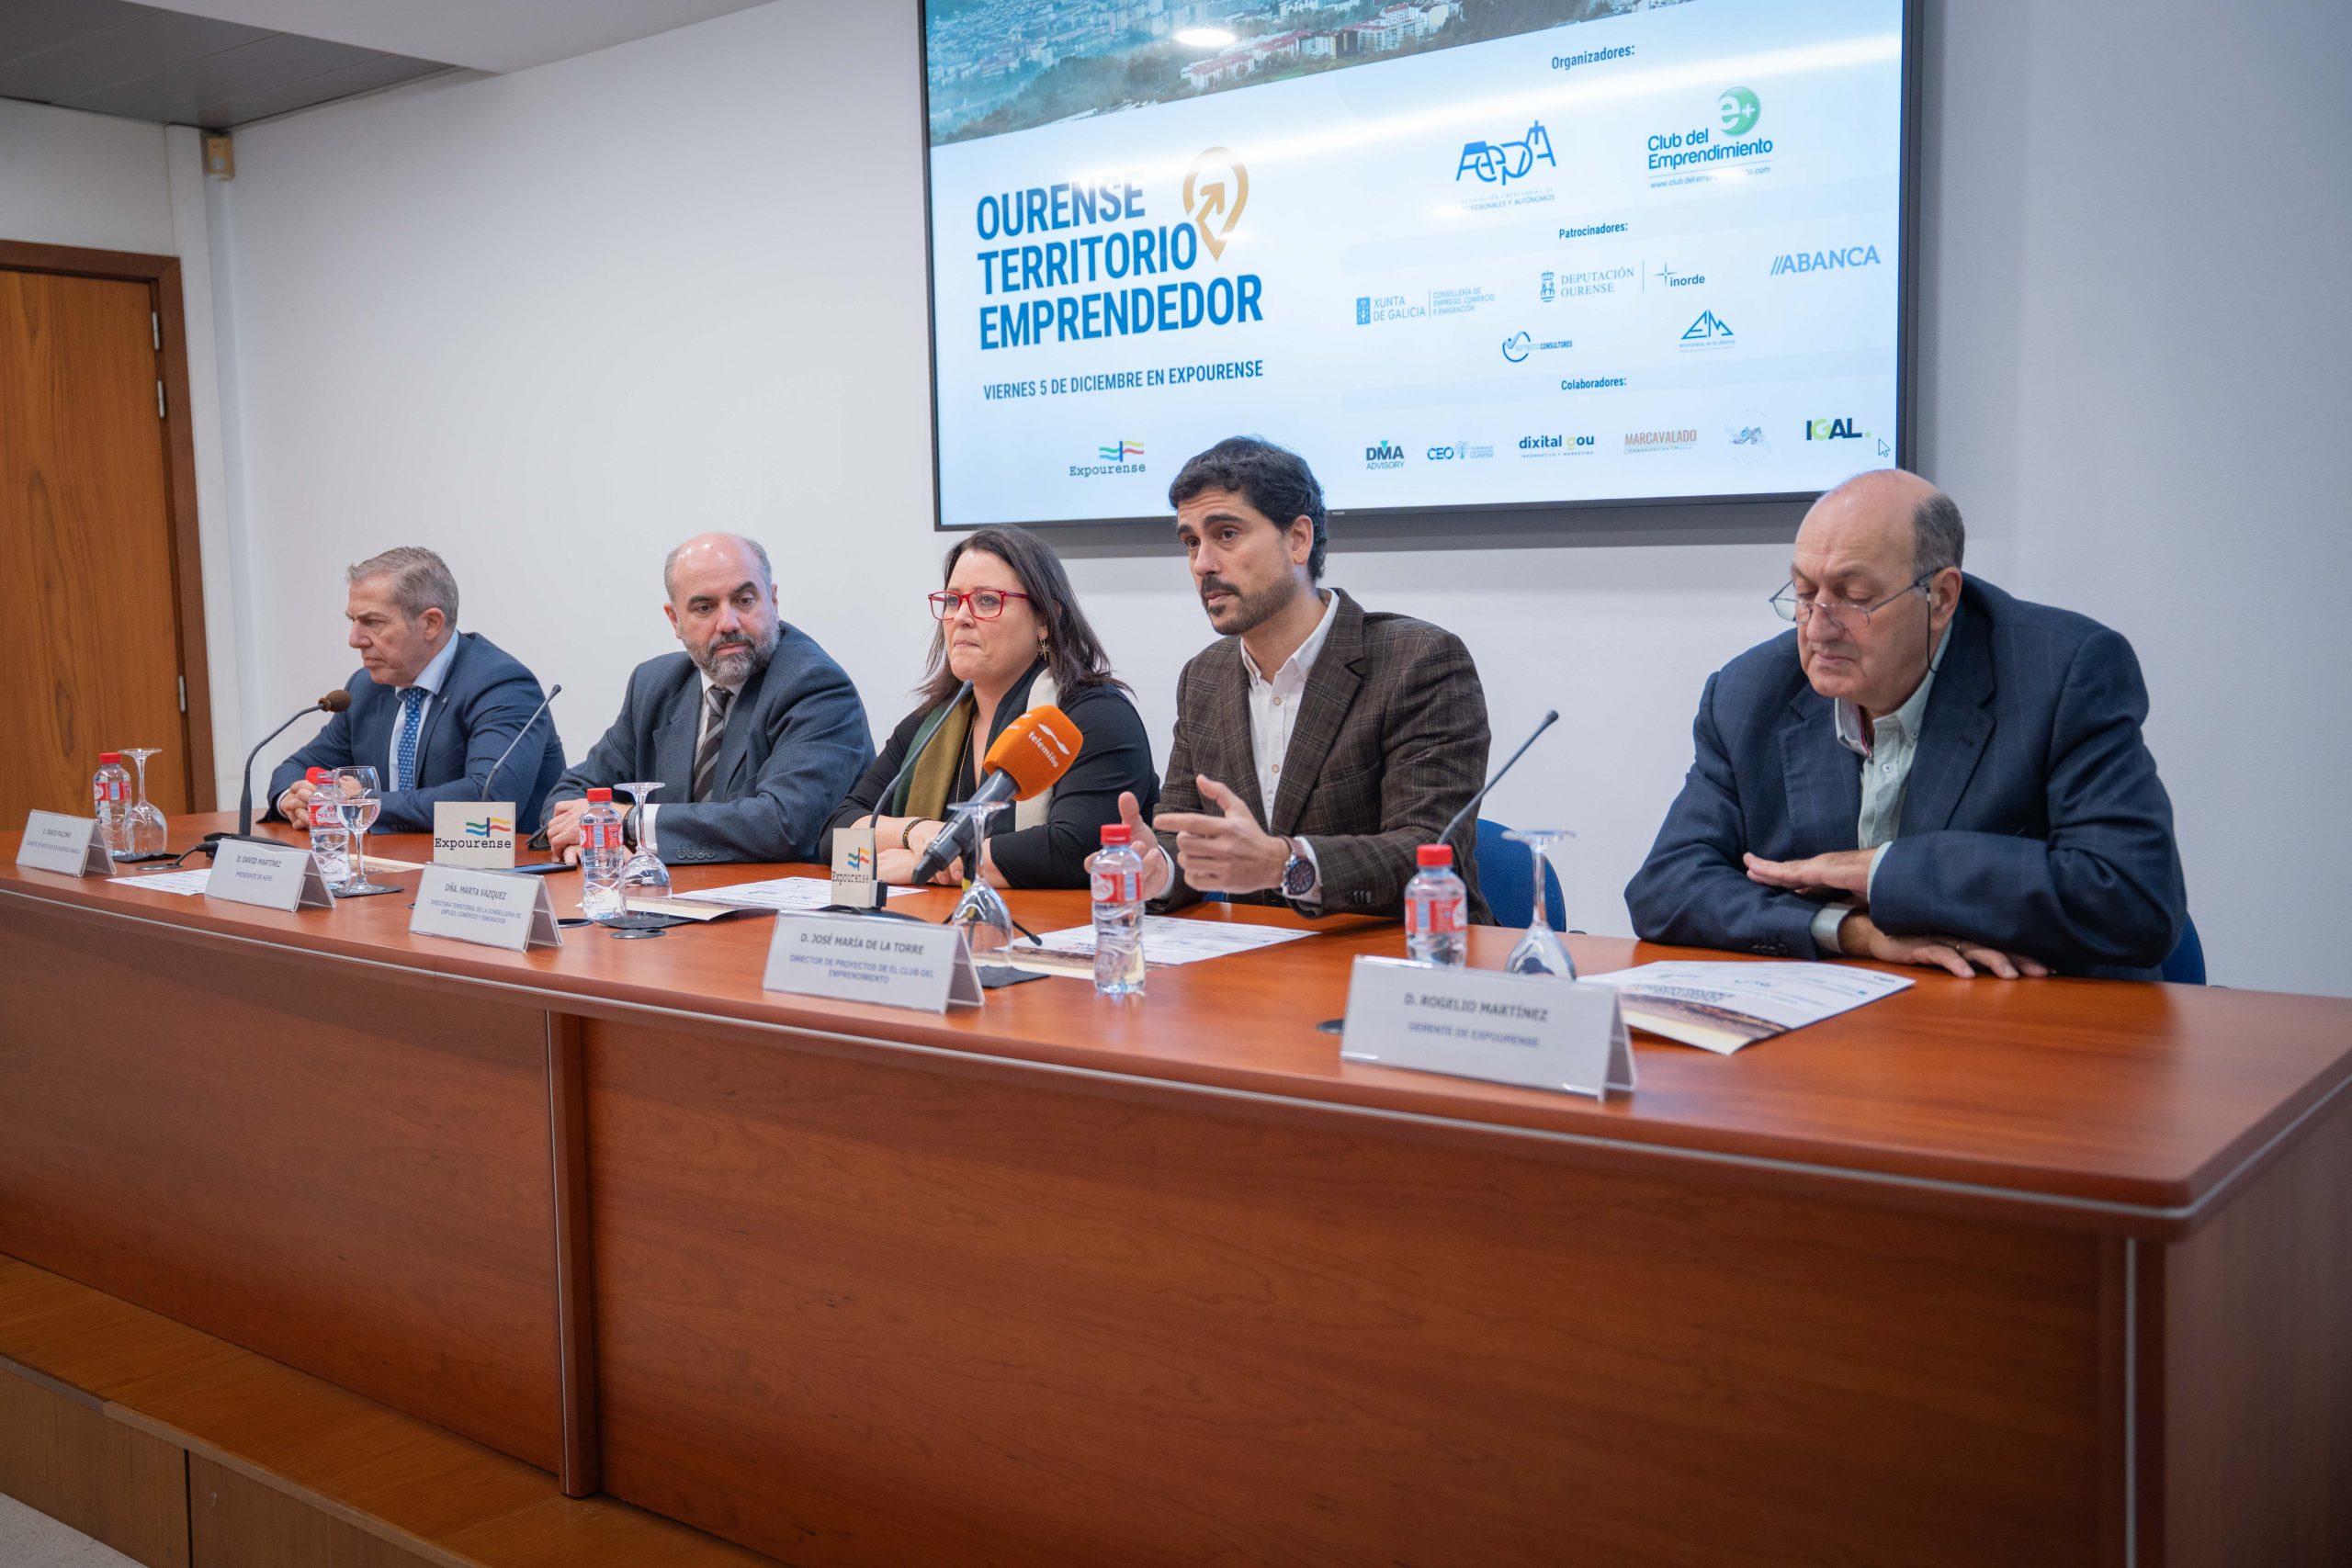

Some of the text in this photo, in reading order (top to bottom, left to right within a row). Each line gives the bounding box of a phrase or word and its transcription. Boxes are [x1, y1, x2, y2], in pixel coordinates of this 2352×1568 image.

[1552, 45, 1635, 71] Organizadores:
[1648, 128, 1709, 152] Club del
[1648, 138, 1773, 170] Emprendimiento
[977, 171, 1145, 240] OURENSE
[1559, 222, 1628, 240] Patrocinadores:
[978, 222, 1196, 295] TERRITORIO
[1562, 266, 1634, 285] DEPUTACIÓN
[1670, 275, 1705, 287] inorde
[1561, 283, 1614, 297] OURENSE
[1374, 296, 1406, 309] XUNTA
[980, 274, 1263, 350] EMPRENDEDOR
[1374, 307, 1426, 321] DE GALICIA
[984, 360, 1263, 400] VIERNES 5 DE DICIEMBRE EN EXPOURENSE
[1561, 377, 1627, 390] Colaboradores:
[1519, 434, 1562, 449] dixital
[1625, 429, 1697, 446] MARCAVALADO
[1366, 446, 1405, 461] DMA
[1427, 446, 1454, 460] CEO
[1069, 463, 1146, 478] Expourense
[1366, 461, 1405, 470] ADVISORY
[435, 838, 511, 851] Expourense
[831, 871, 869, 886] Expourense
[459, 886, 479, 896] MARTA
[800, 932, 924, 955] D. JOSÉ MARÍA DE LA TORRE
[1404, 992, 1416, 1006] D.
[1419, 994, 1477, 1013] ROGELIO
